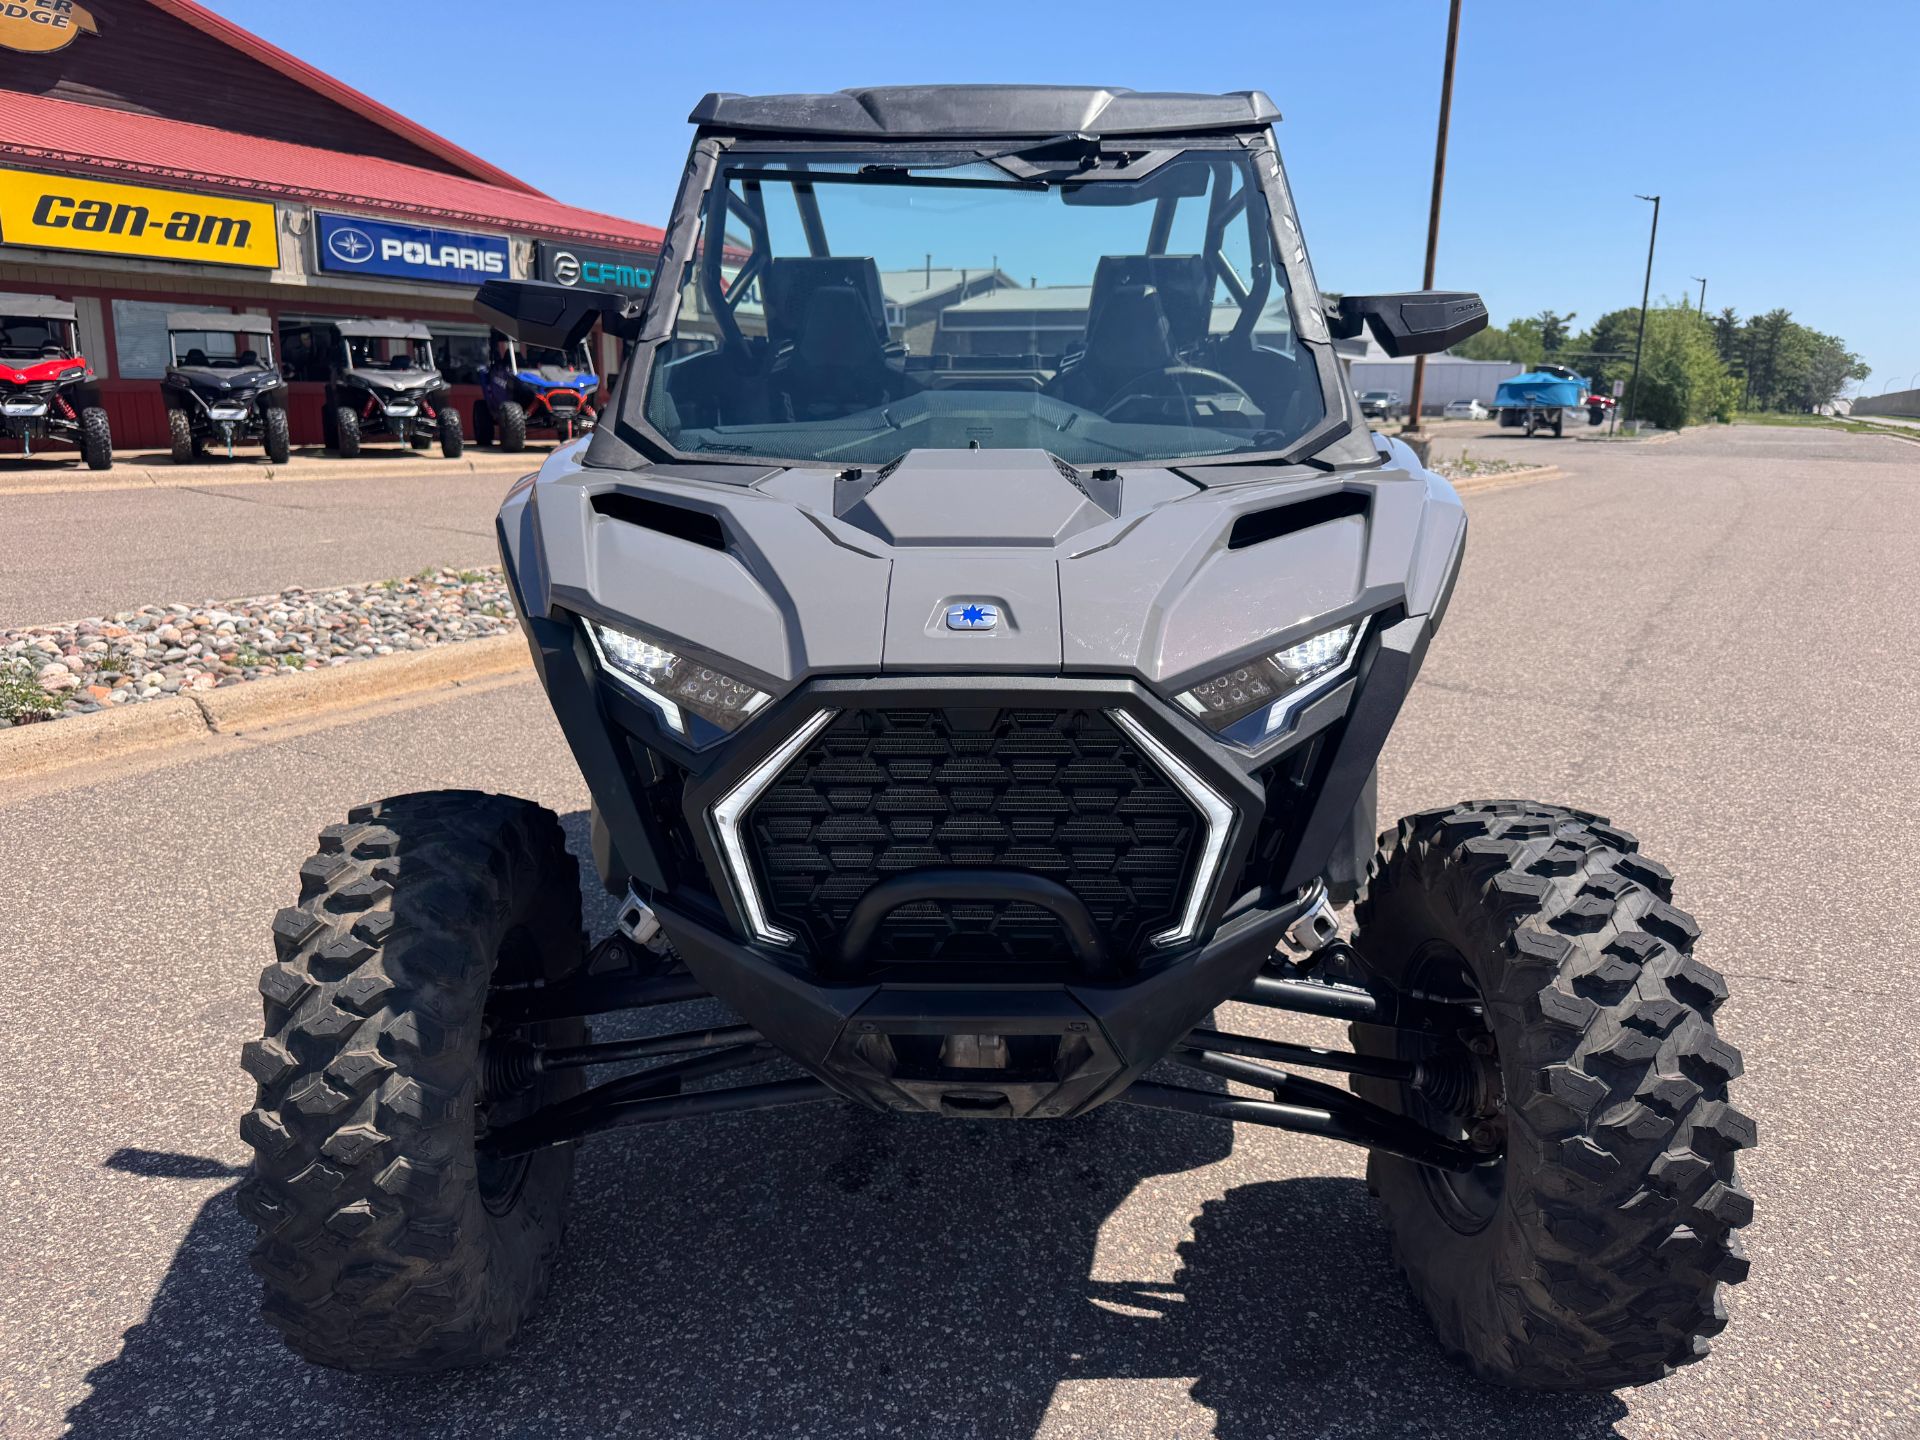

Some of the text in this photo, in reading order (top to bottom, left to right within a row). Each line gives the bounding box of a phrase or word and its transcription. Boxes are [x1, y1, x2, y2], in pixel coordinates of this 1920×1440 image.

[0, 3, 70, 29] DGE
[19, 0, 73, 14] ER
[381, 238, 504, 273] POLARIS
